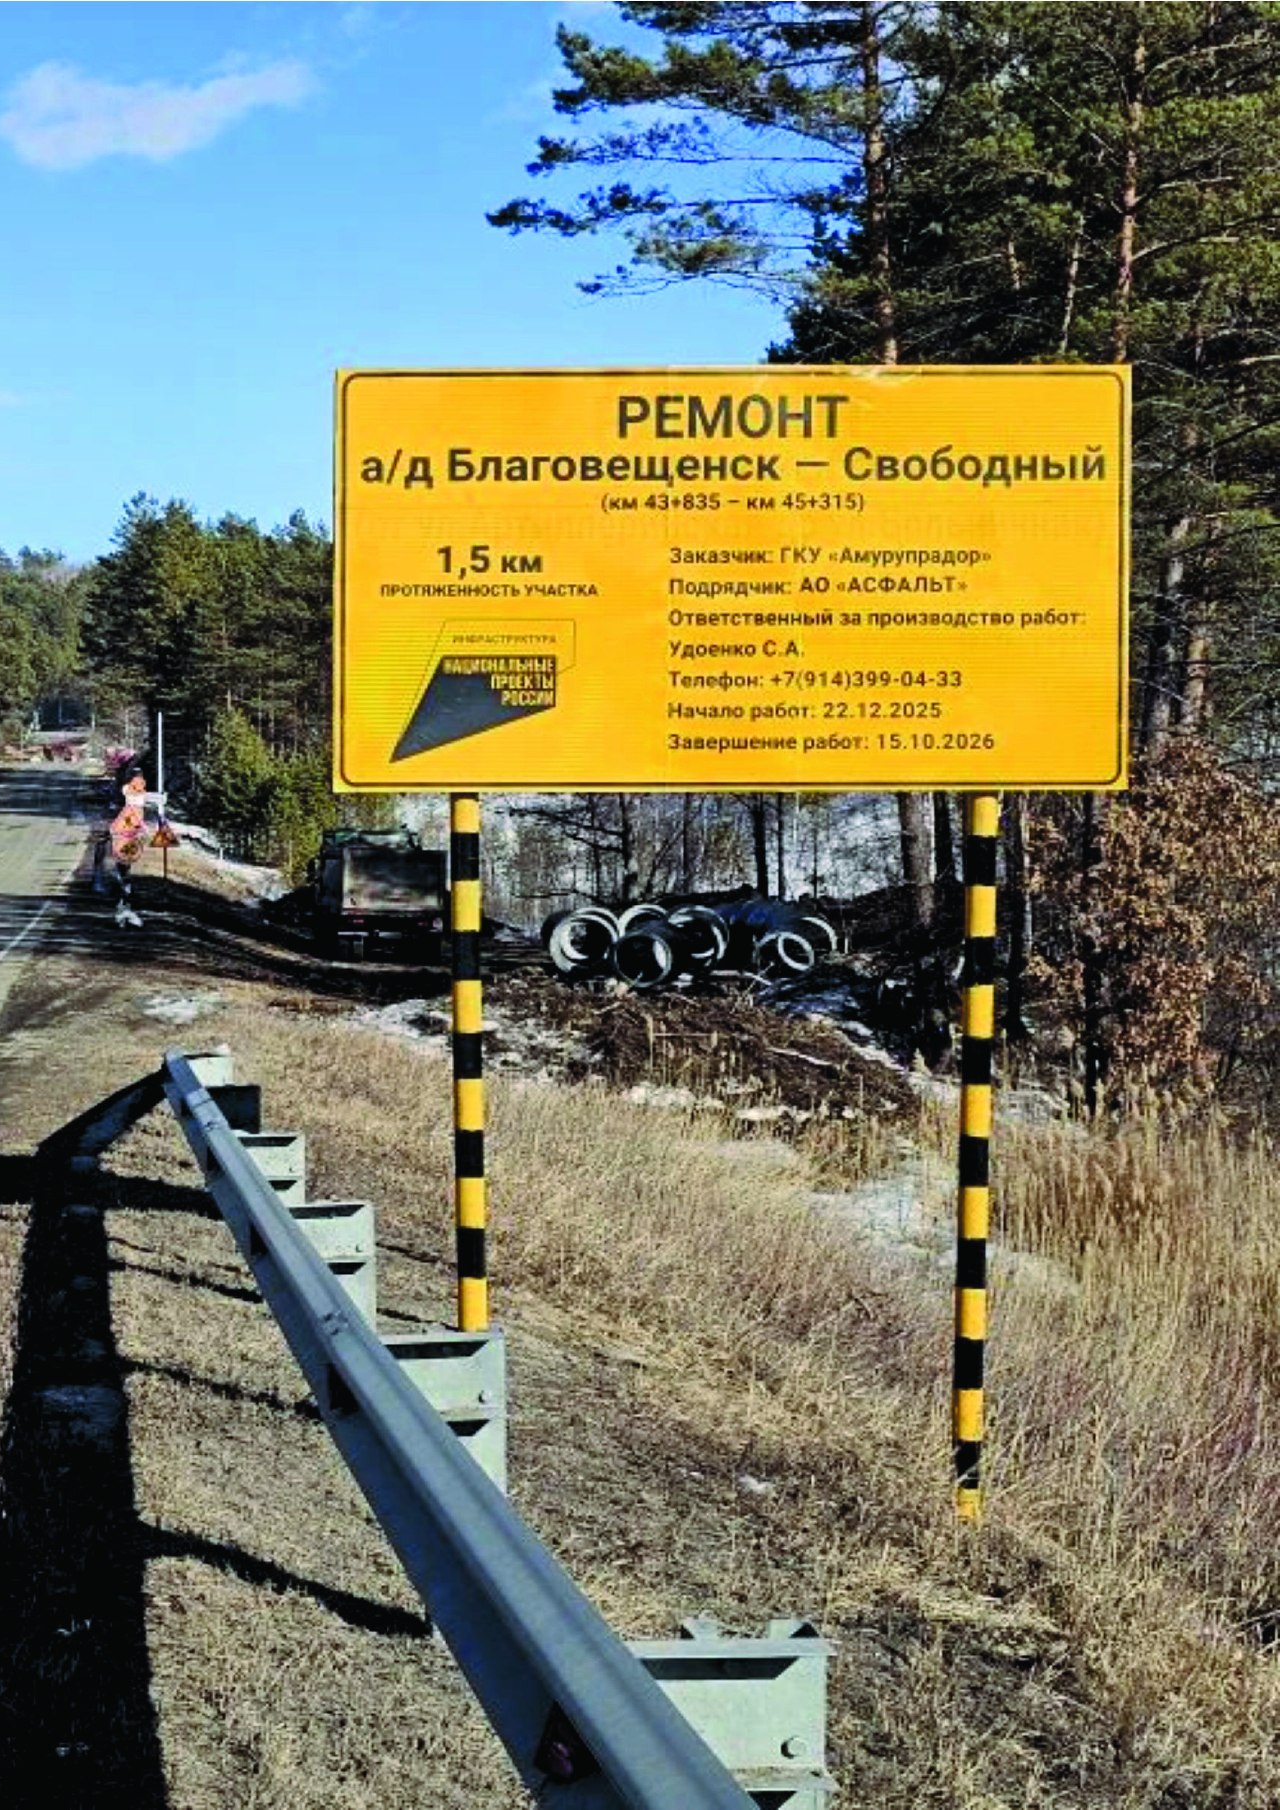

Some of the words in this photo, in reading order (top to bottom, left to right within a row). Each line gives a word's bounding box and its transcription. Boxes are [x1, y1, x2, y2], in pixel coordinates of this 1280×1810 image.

[617, 394, 849, 440] РЕМОНТ
[360, 449, 434, 488] а/д
[447, 447, 781, 488] Благовещенск
[844, 444, 1106, 488] Свободный
[601, 493, 638, 513] (км
[644, 494, 721, 511] 43+835
[746, 496, 774, 511] км
[782, 493, 864, 512] 45+315)
[437, 545, 490, 580] 1,5
[500, 555, 544, 574] км
[670, 547, 774, 564] Заказчик:
[780, 547, 821, 564] ГКУ
[828, 547, 992, 567] «Амурупрадор»
[380, 583, 520, 599] ПРОТЯЖЕННОСТЬ
[524, 583, 598, 598] УЧАСТКА
[669, 579, 792, 599] Подрядчик:
[799, 577, 830, 593] АО
[836, 576, 968, 594] «АСФАЛЬТ»
[668, 609, 834, 627] Ответственный
[839, 612, 862, 627] за
[867, 612, 1016, 630] производство
[1020, 608, 1088, 630] работ:
[669, 640, 757, 660] Удоенко
[762, 639, 805, 658] С.А.
[442, 658, 555, 674] НАЦИОНАЛЬНЫЕ
[490, 673, 554, 690] ПРОЕКТЫ
[669, 671, 765, 692] Телефон:
[770, 670, 963, 692] +7(914)399-04-33
[501, 690, 554, 706] РОССИИ
[668, 702, 745, 719] Начало
[750, 700, 816, 722] работ:
[823, 701, 942, 719] 22.12.2025
[668, 733, 798, 753] Завершение
[803, 731, 870, 754] работ:
[877, 732, 996, 750] 15.10.2026
